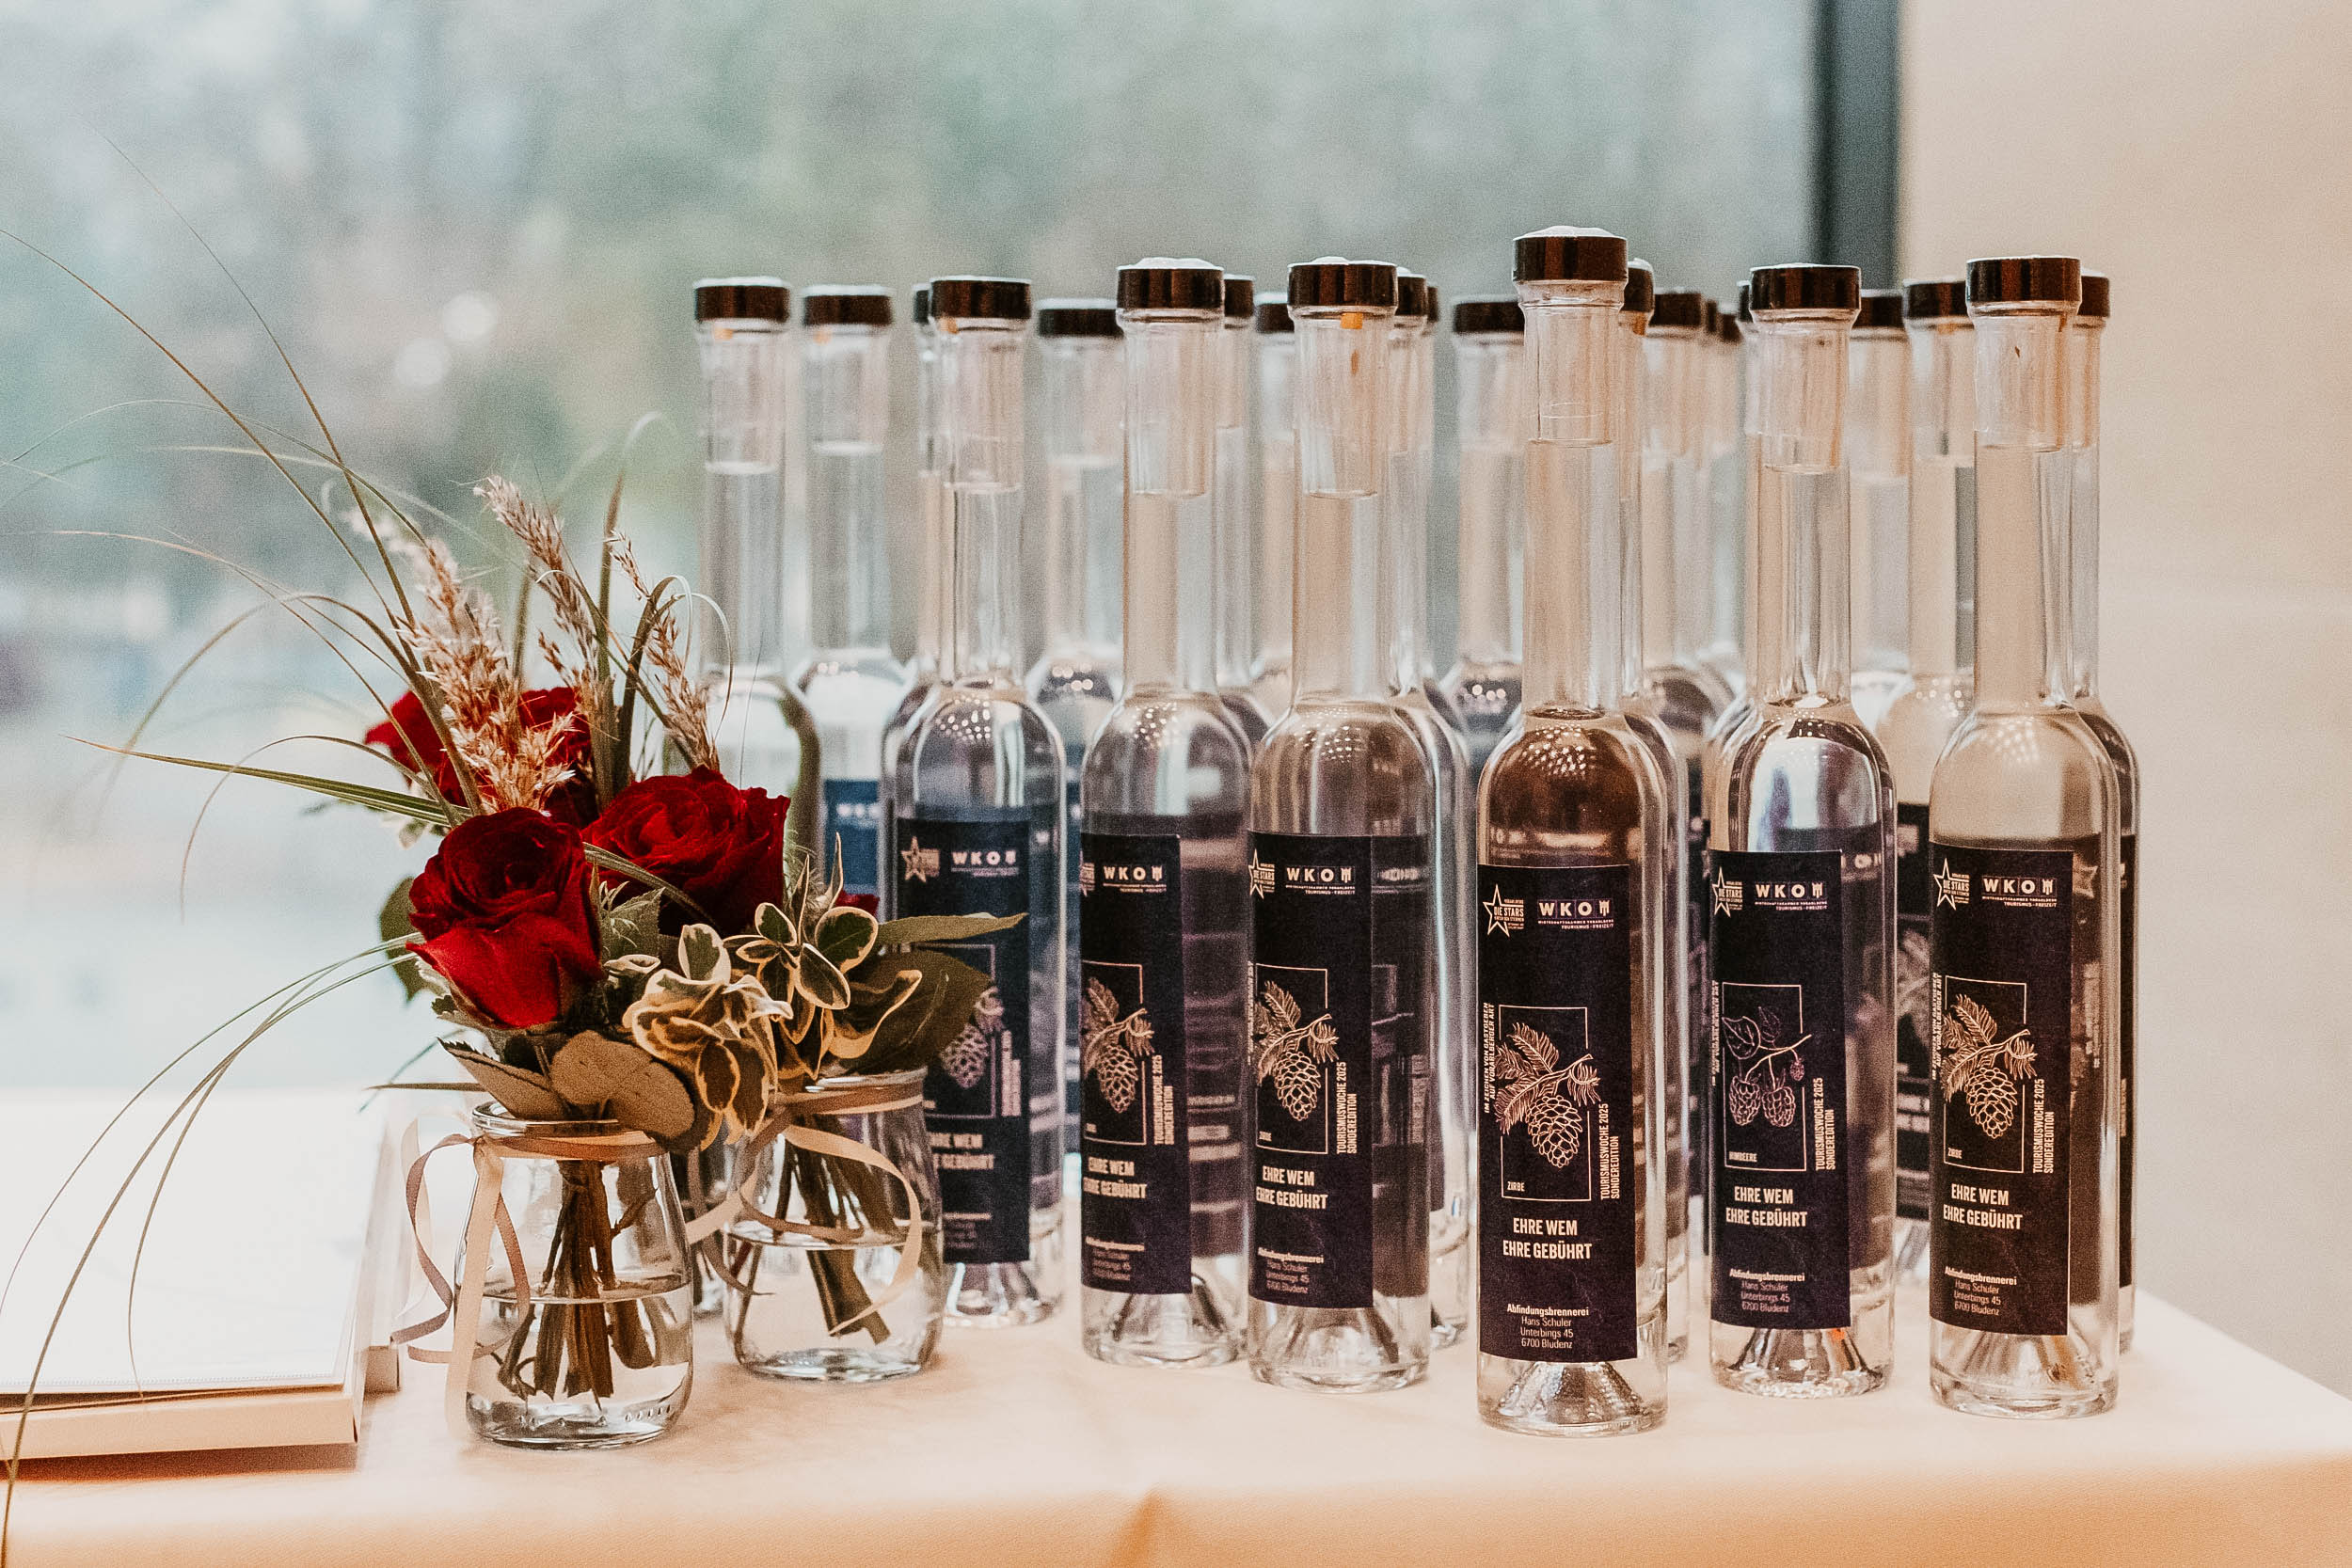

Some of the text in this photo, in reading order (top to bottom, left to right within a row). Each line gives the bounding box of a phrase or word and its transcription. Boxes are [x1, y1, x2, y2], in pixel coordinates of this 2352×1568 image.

[1103, 865, 1147, 881] WKO
[1286, 867, 1335, 881] WKO
[1755, 883, 1805, 898] WKO
[1983, 879, 2036, 895] WKO
[1538, 901, 1594, 917] WKO
[1336, 1061, 1347, 1154] TOURISMUSWOCHE 2025
[1484, 1102, 1490, 1114] IM
[1346, 1093, 1358, 1154] SONDEREDITION
[1813, 1077, 1825, 1172] TOURISMUSWOCHE 2025
[2033, 1078, 2045, 1174] TOURISMUSWOCHE 2025
[1824, 1109, 1836, 1171] SONDEREDITION
[2043, 1111, 2055, 1174] SONDEREDITION
[1598, 1102, 1610, 1201] TOURISMUSWOCHE 2025
[1262, 1165, 1315, 1186] EHRE WEM
[1610, 1135, 1620, 1199] SONDEREDITION
[1506, 1180, 1525, 1192] ZIRBE
[1734, 1185, 1794, 1205] EHRE WEM
[1950, 1183, 2010, 1206] EHRE WEM
[1256, 1186, 1328, 1210] EHRE GEBÜHRT
[1513, 1217, 1578, 1236] EHRE WEM
[1725, 1207, 1808, 1227] EHRE GEBÜHRT
[1943, 1204, 2023, 1229] EHRE GEBÜHRT
[1502, 1239, 1593, 1259] EHRE GEBÜHRT
[1779, 1293, 1790, 1303] 45
[1991, 1295, 2001, 1306] 45
[1506, 1303, 1589, 1318] Abfindungsbrennerei
[1521, 1317, 1572, 1327] Hans Schuler
[1519, 1327, 1574, 1339] Unterbings 45
[1520, 1338, 1573, 1349] 6700 Bludenz
